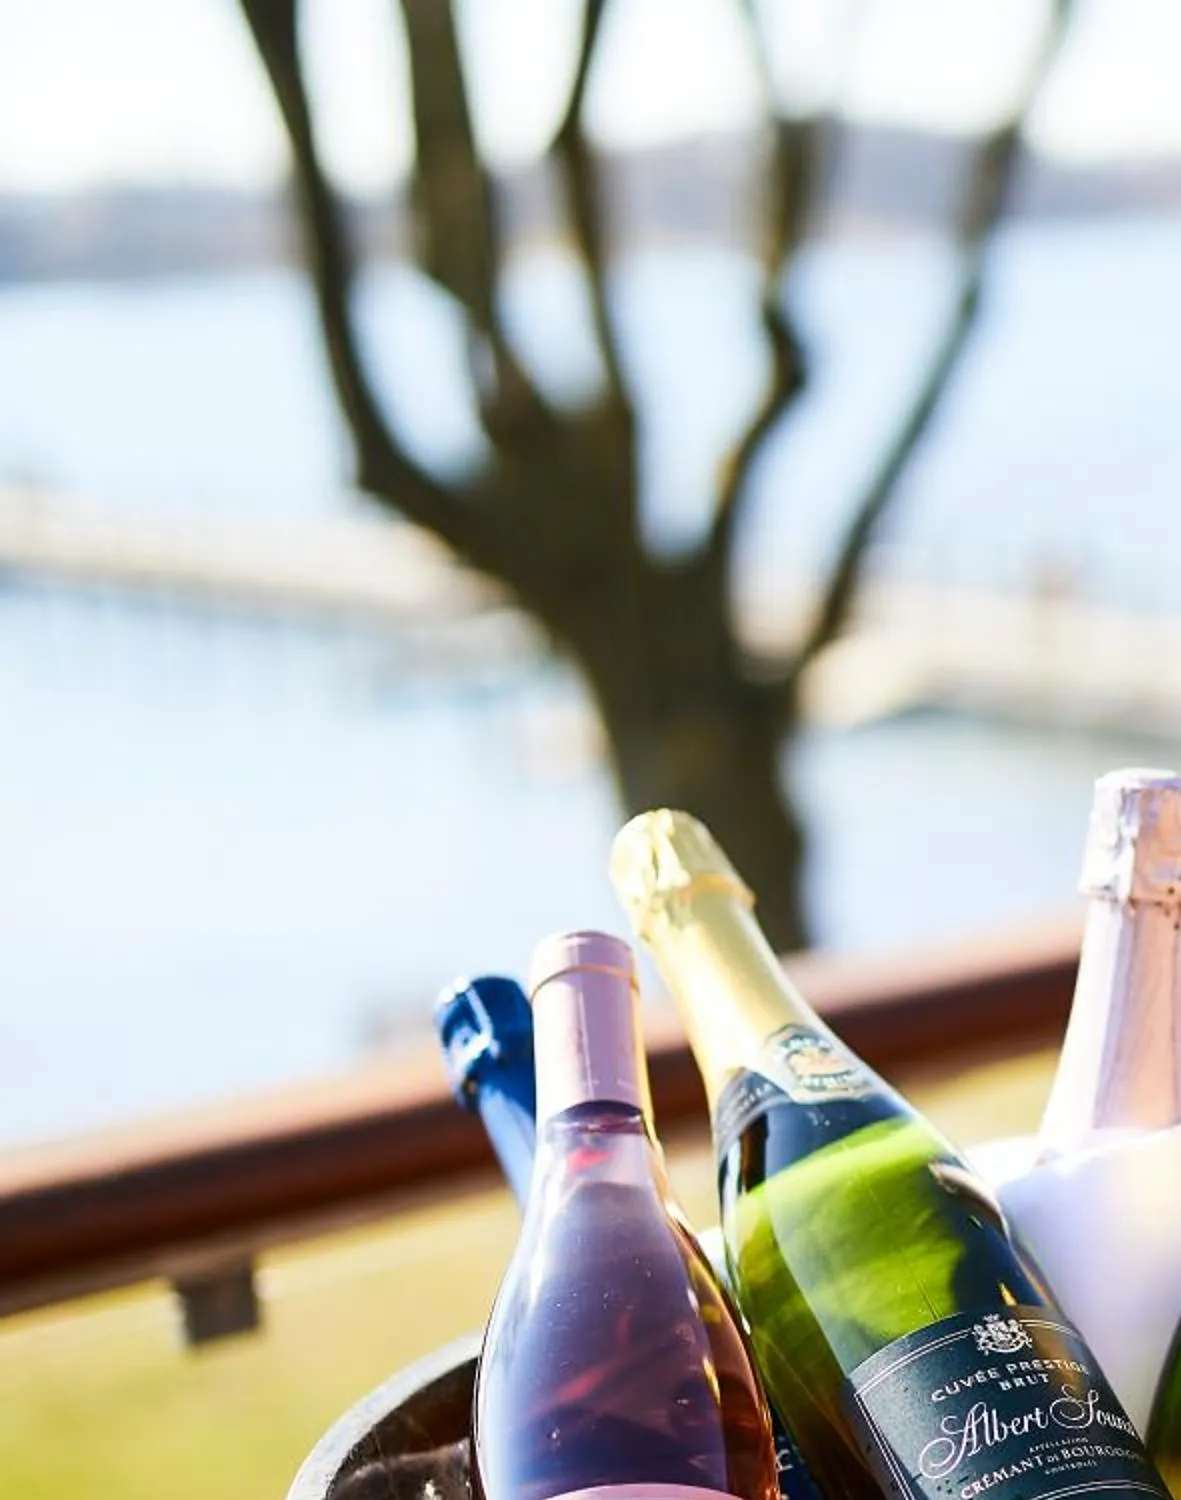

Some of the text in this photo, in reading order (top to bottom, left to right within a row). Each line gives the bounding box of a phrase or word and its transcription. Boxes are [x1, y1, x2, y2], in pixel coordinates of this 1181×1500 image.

[998, 1373, 1050, 1392] BRUT
[918, 1383, 1139, 1480] Albert Soun
